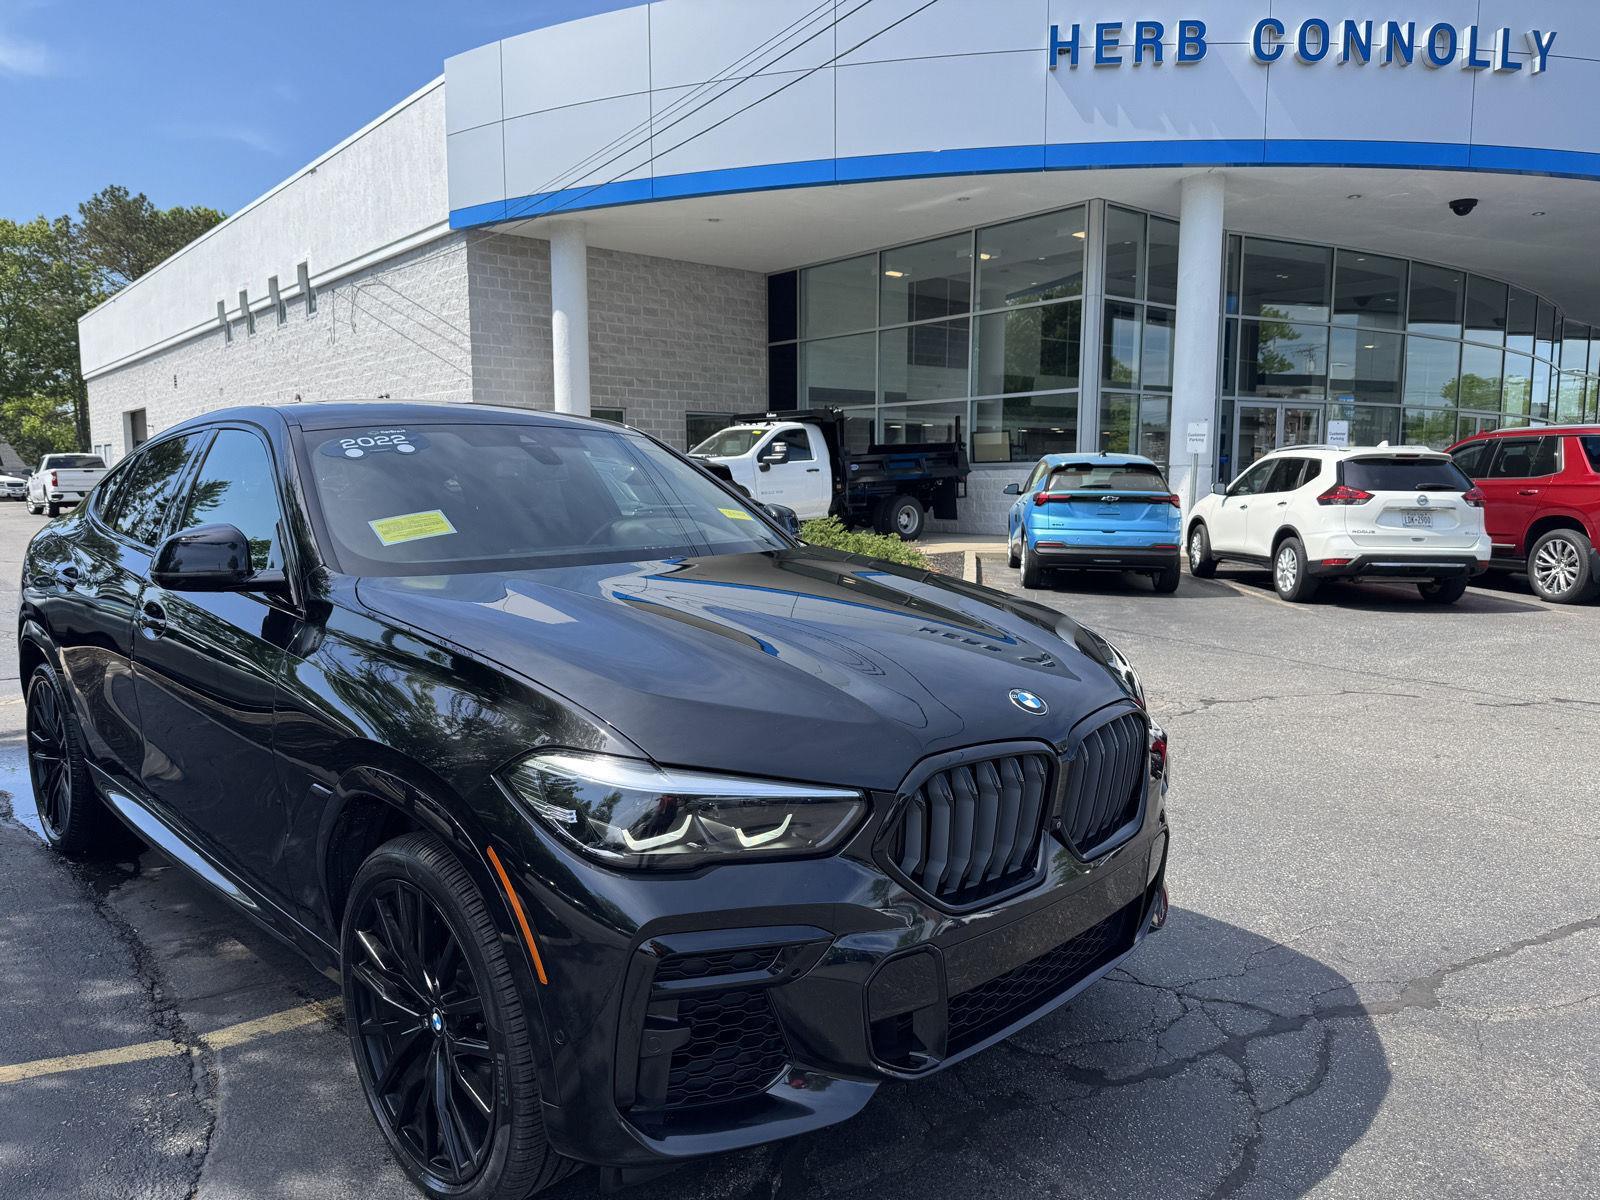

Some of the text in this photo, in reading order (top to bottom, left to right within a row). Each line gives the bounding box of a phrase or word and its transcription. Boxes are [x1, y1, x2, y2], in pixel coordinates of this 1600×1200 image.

[1049, 18, 1557, 74] HERB CONNOLLY
[340, 434, 409, 448] 2022
